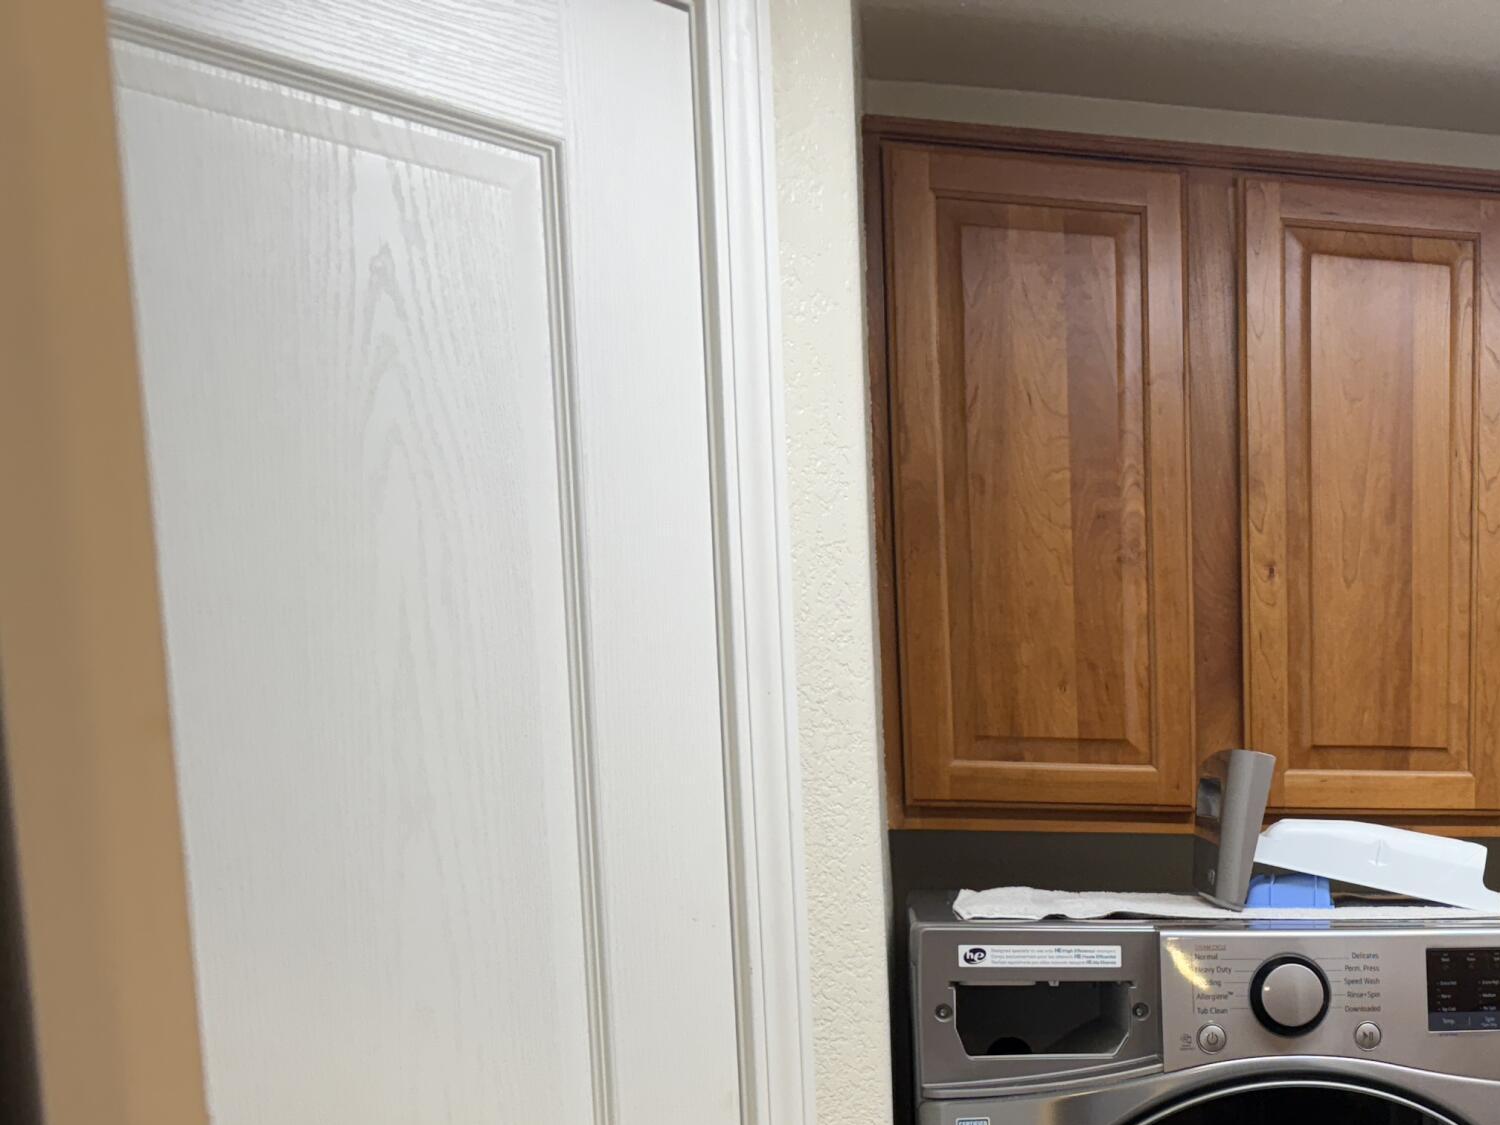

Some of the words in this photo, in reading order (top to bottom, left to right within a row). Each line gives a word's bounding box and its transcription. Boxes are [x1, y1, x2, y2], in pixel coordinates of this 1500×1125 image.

[1217, 966, 1232, 974] Duty
[1344, 978, 1362, 986] Speed
[1197, 1007, 1208, 1015] Tub
[1209, 1007, 1228, 1015] Clean
